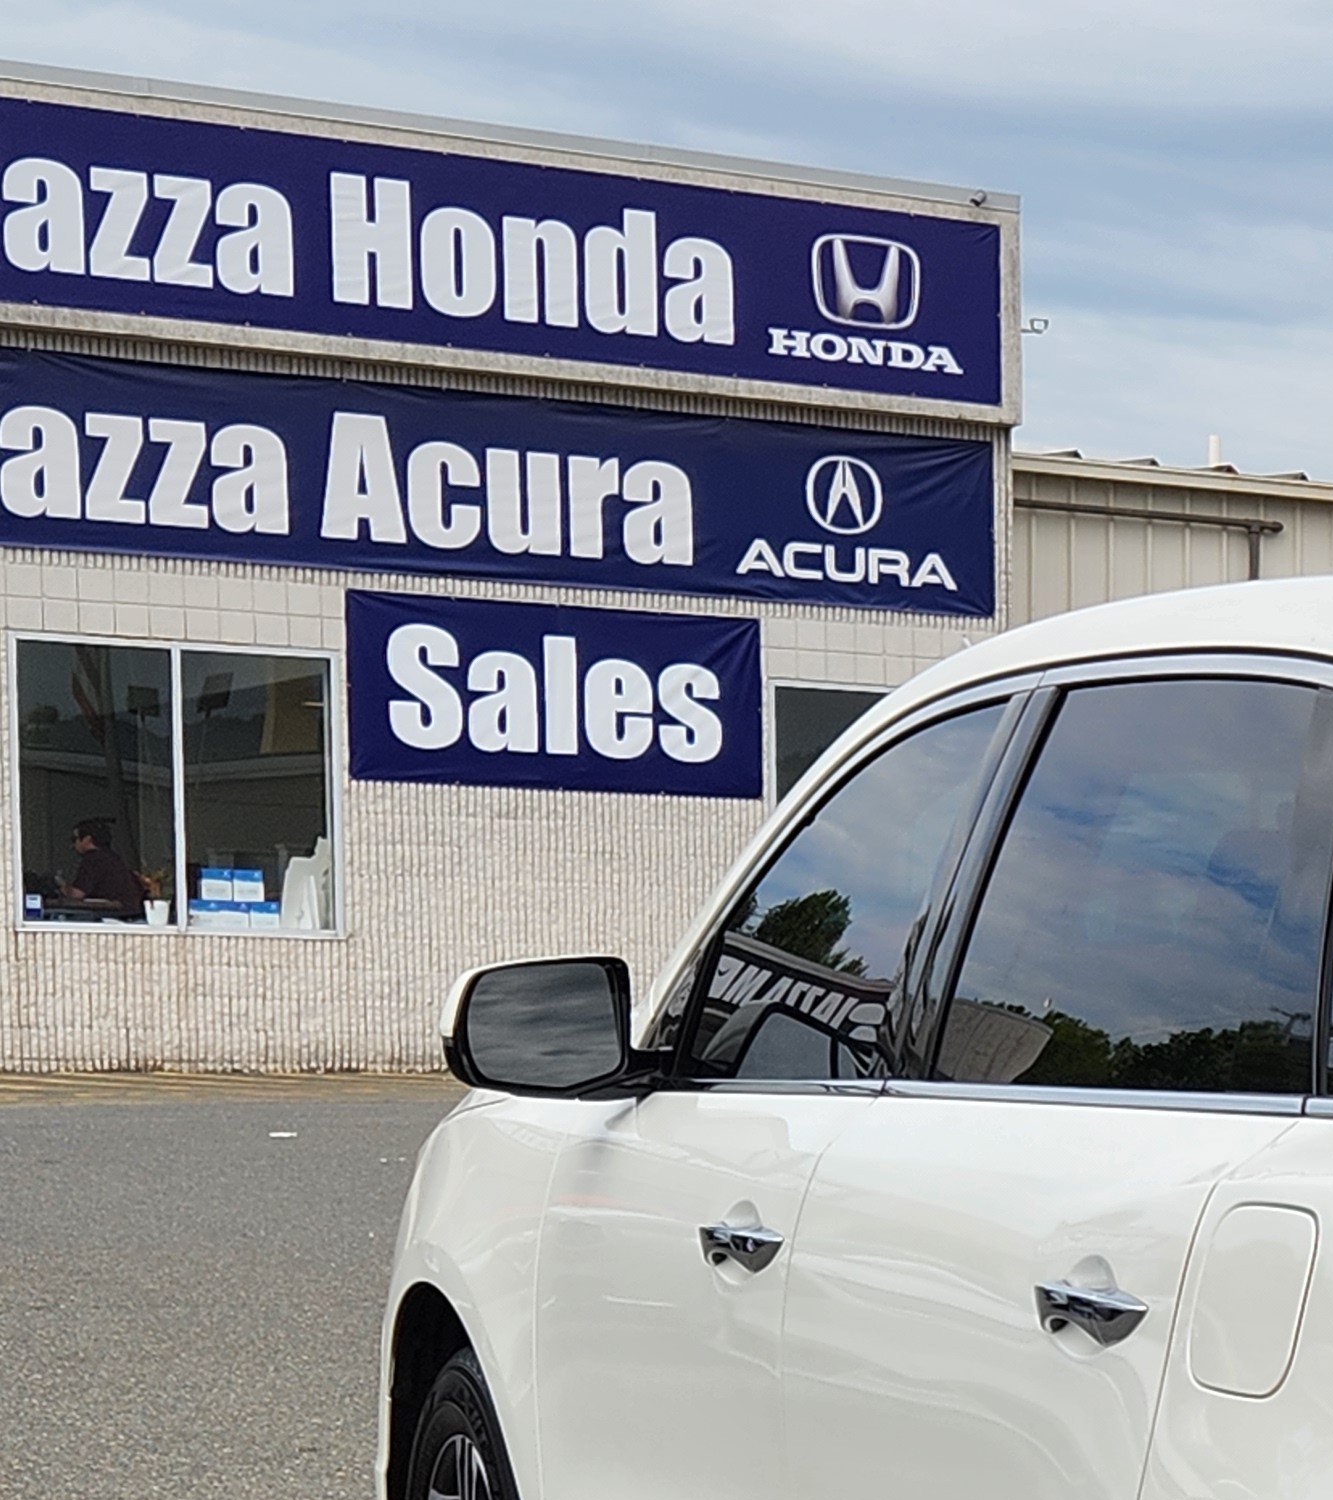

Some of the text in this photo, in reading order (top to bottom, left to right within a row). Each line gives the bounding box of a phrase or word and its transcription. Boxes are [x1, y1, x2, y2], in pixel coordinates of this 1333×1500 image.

[330, 171, 736, 347] Honda
[768, 327, 964, 375] HONDA
[320, 411, 694, 566] Acura
[736, 538, 958, 591] ACURA
[386, 623, 723, 763] Sales
